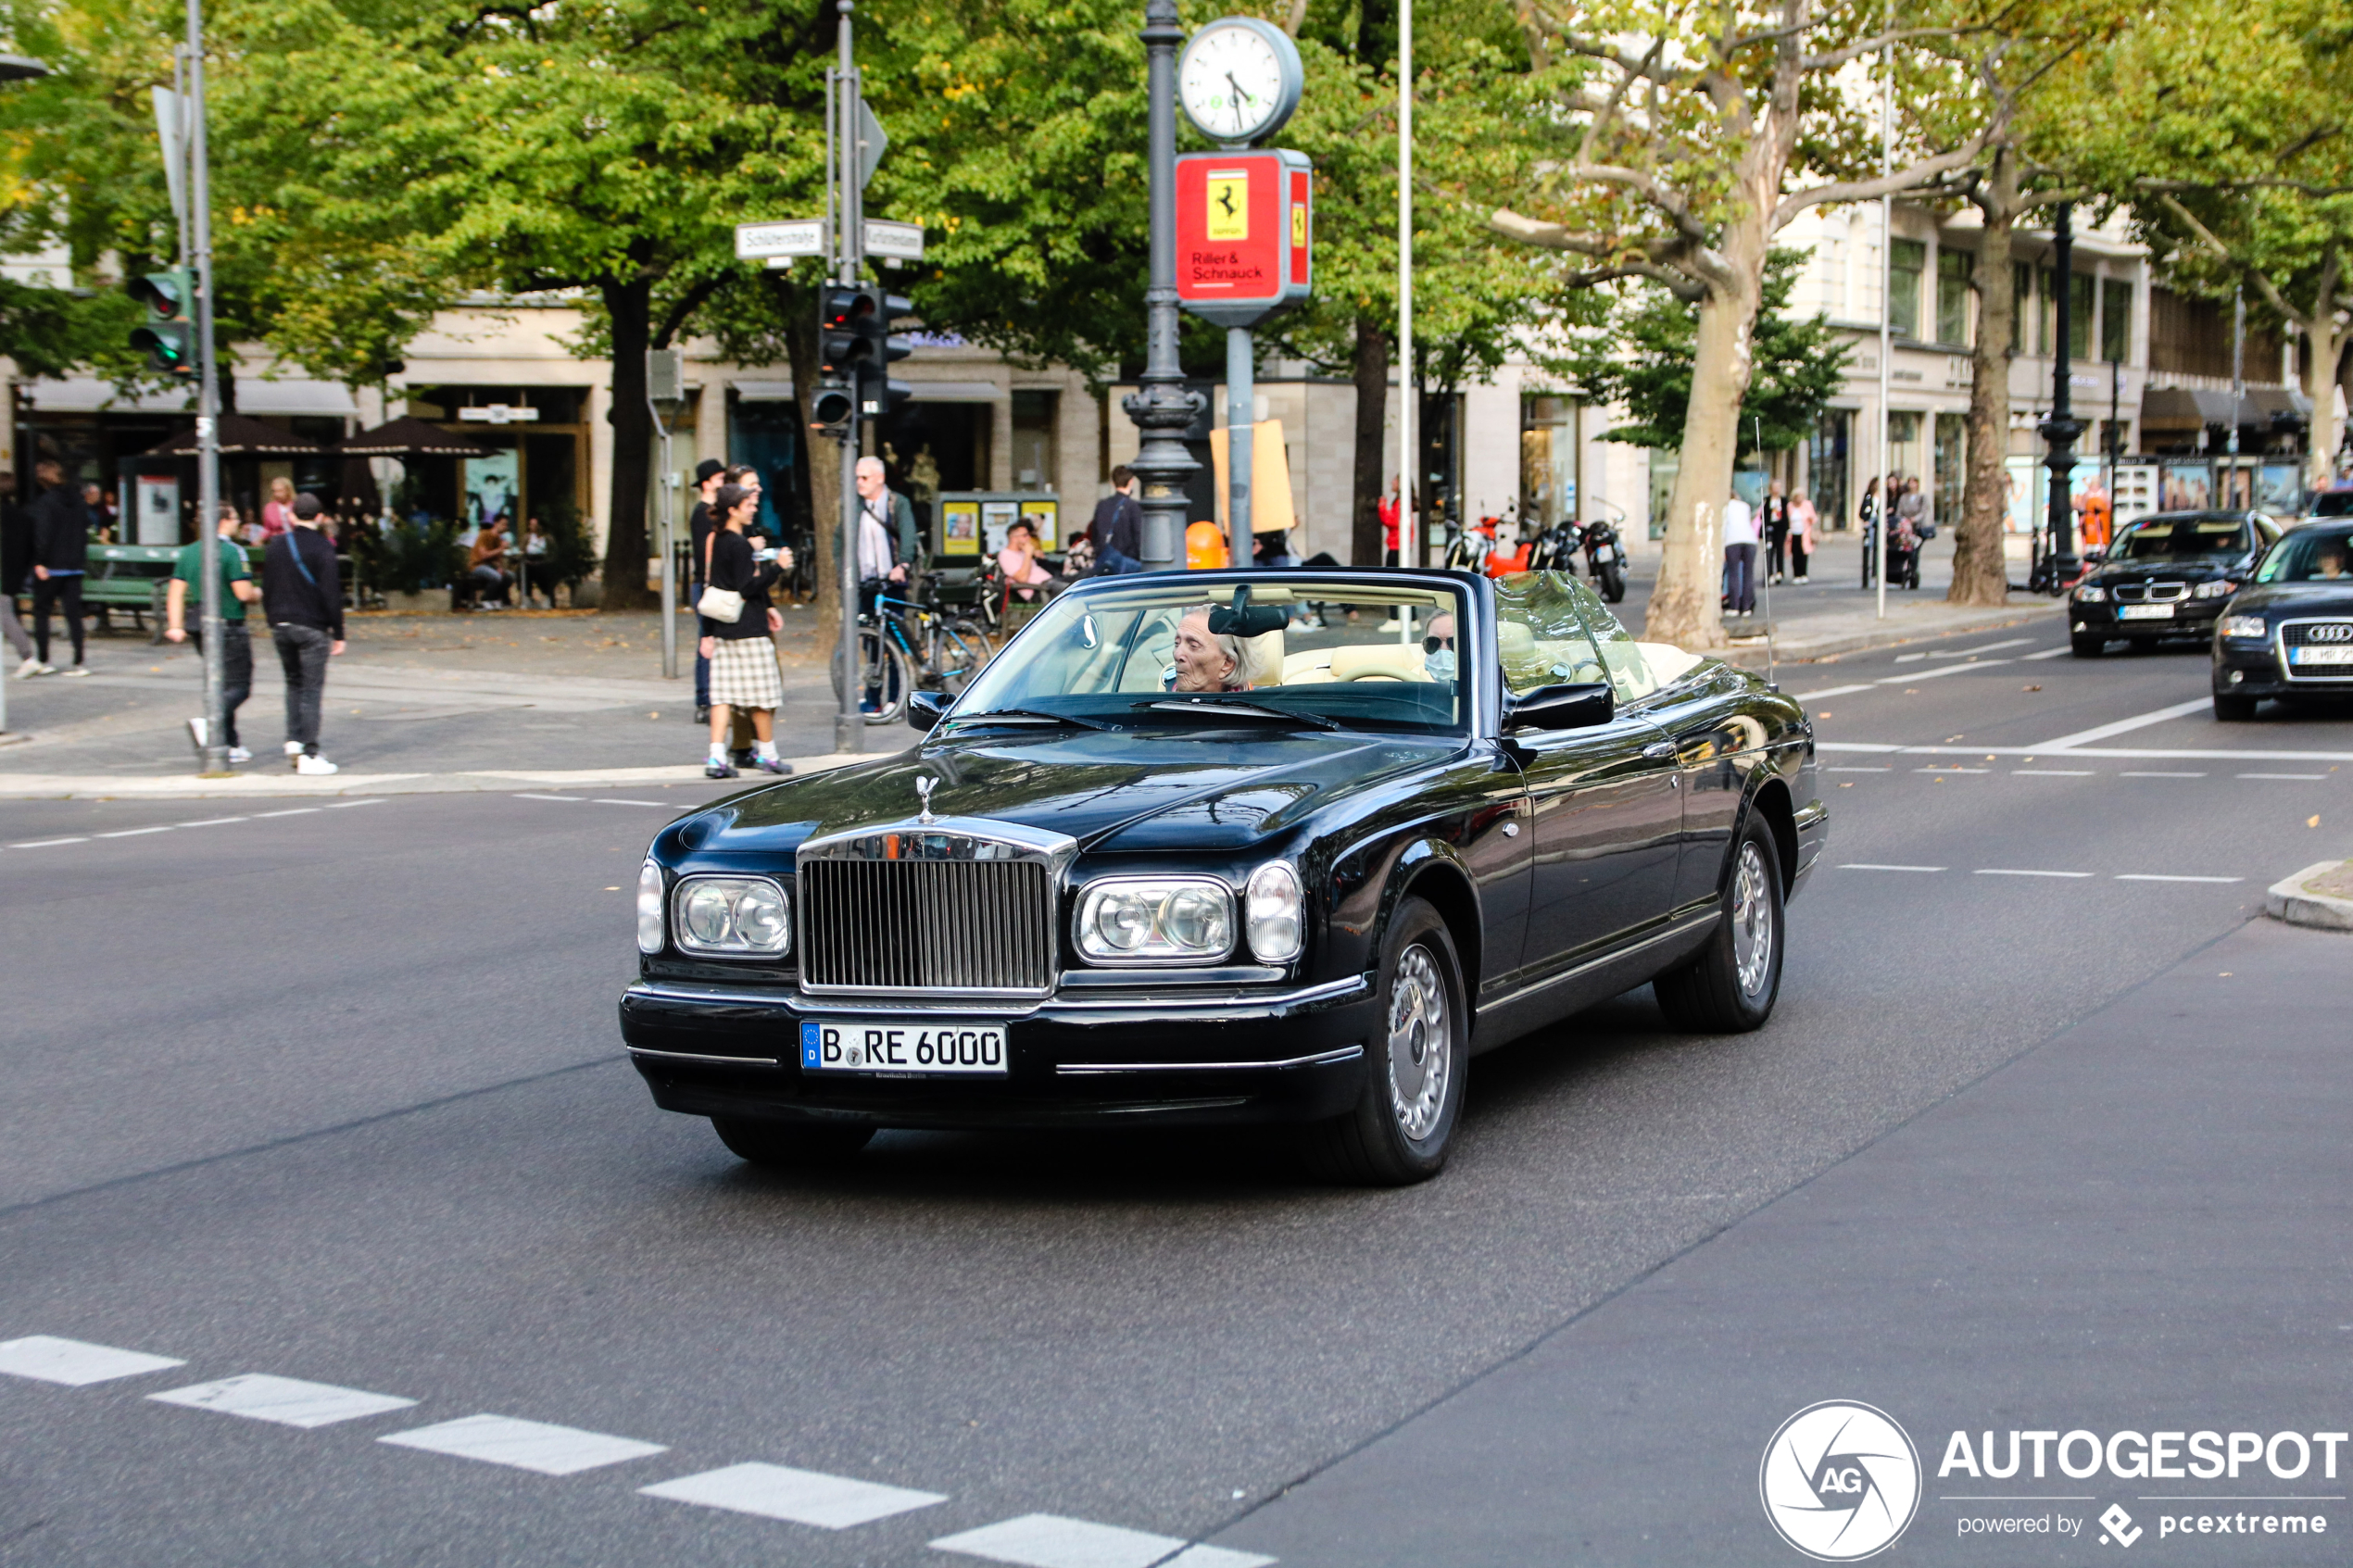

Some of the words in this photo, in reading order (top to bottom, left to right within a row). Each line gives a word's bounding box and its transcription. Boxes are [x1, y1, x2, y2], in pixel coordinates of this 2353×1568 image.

[1192, 252, 1226, 265] Riller
[1229, 251, 1239, 264] &
[1192, 266, 1263, 280] Schnauck
[823, 1028, 842, 1062] B
[864, 1030, 908, 1064] RE
[916, 1031, 1001, 1065] 6000
[809, 1049, 816, 1060] D
